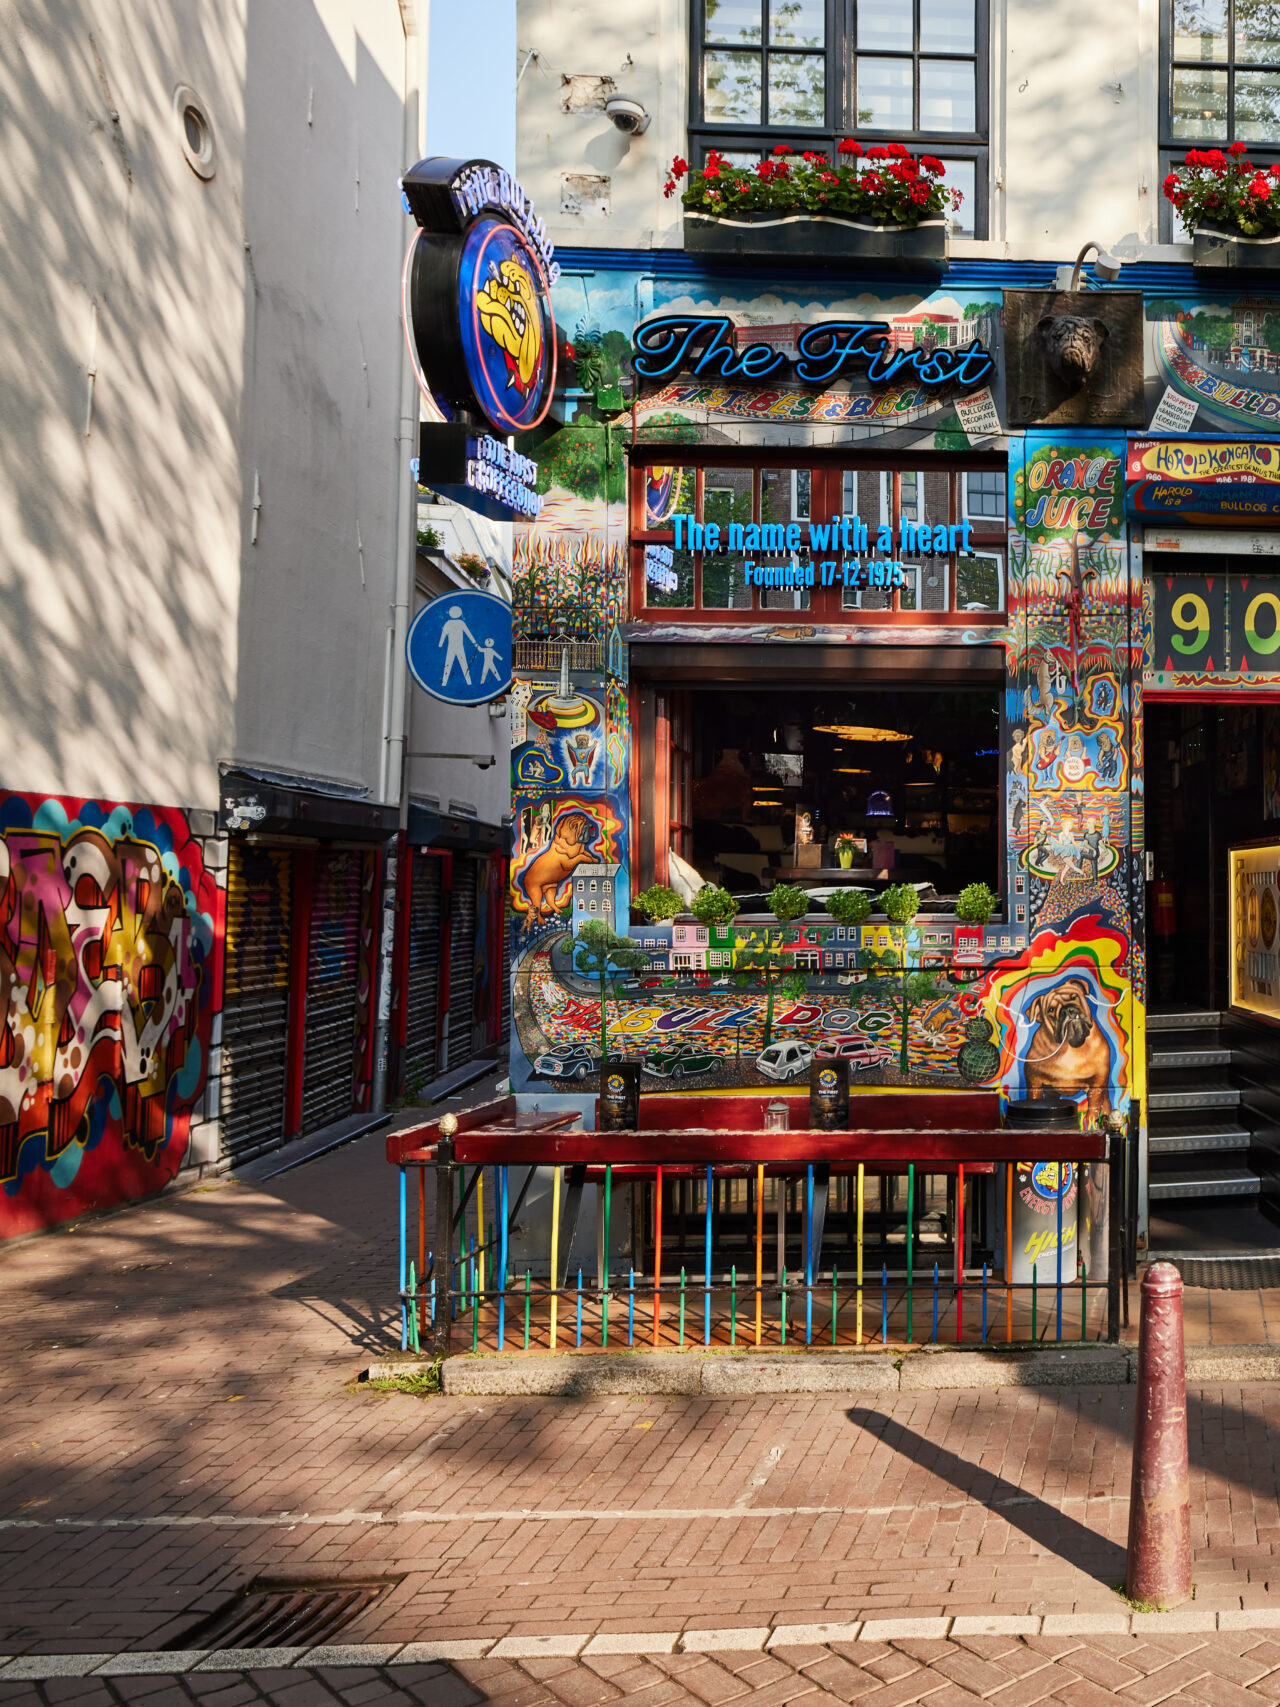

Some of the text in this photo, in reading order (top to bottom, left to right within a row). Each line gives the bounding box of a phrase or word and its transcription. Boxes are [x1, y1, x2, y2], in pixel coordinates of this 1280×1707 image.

[634, 317, 993, 386] The First
[750, 391, 829, 416] BEST
[824, 403, 843, 418] &
[846, 386, 932, 418] BIGGE
[957, 399, 971, 408] STOP
[960, 402, 994, 417] BULLDOGS
[1167, 392, 1195, 411] STOP PRESS
[962, 411, 996, 426] DECORATE
[983, 421, 999, 430] HALL
[1155, 413, 1188, 430] LEIDSEPLEIN
[1157, 444, 1207, 475] HAROLD
[1199, 467, 1210, 476] THE
[1212, 463, 1242, 474] GREATEST
[1243, 464, 1269, 476] GENIUS
[1029, 456, 1121, 492] ORANGE
[1152, 486, 1193, 501] HAROLD
[1165, 497, 1173, 506] is
[1026, 496, 1114, 529] JUICE
[1220, 500, 1268, 512] BULLDOG
[670, 514, 974, 552] The name with a heart
[745, 561, 904, 586] Founded 17-12-1975
[552, 999, 609, 1031] The
[1019, 1185, 1056, 1215] ENERGY
[1024, 1221, 1077, 1265] HIGH
